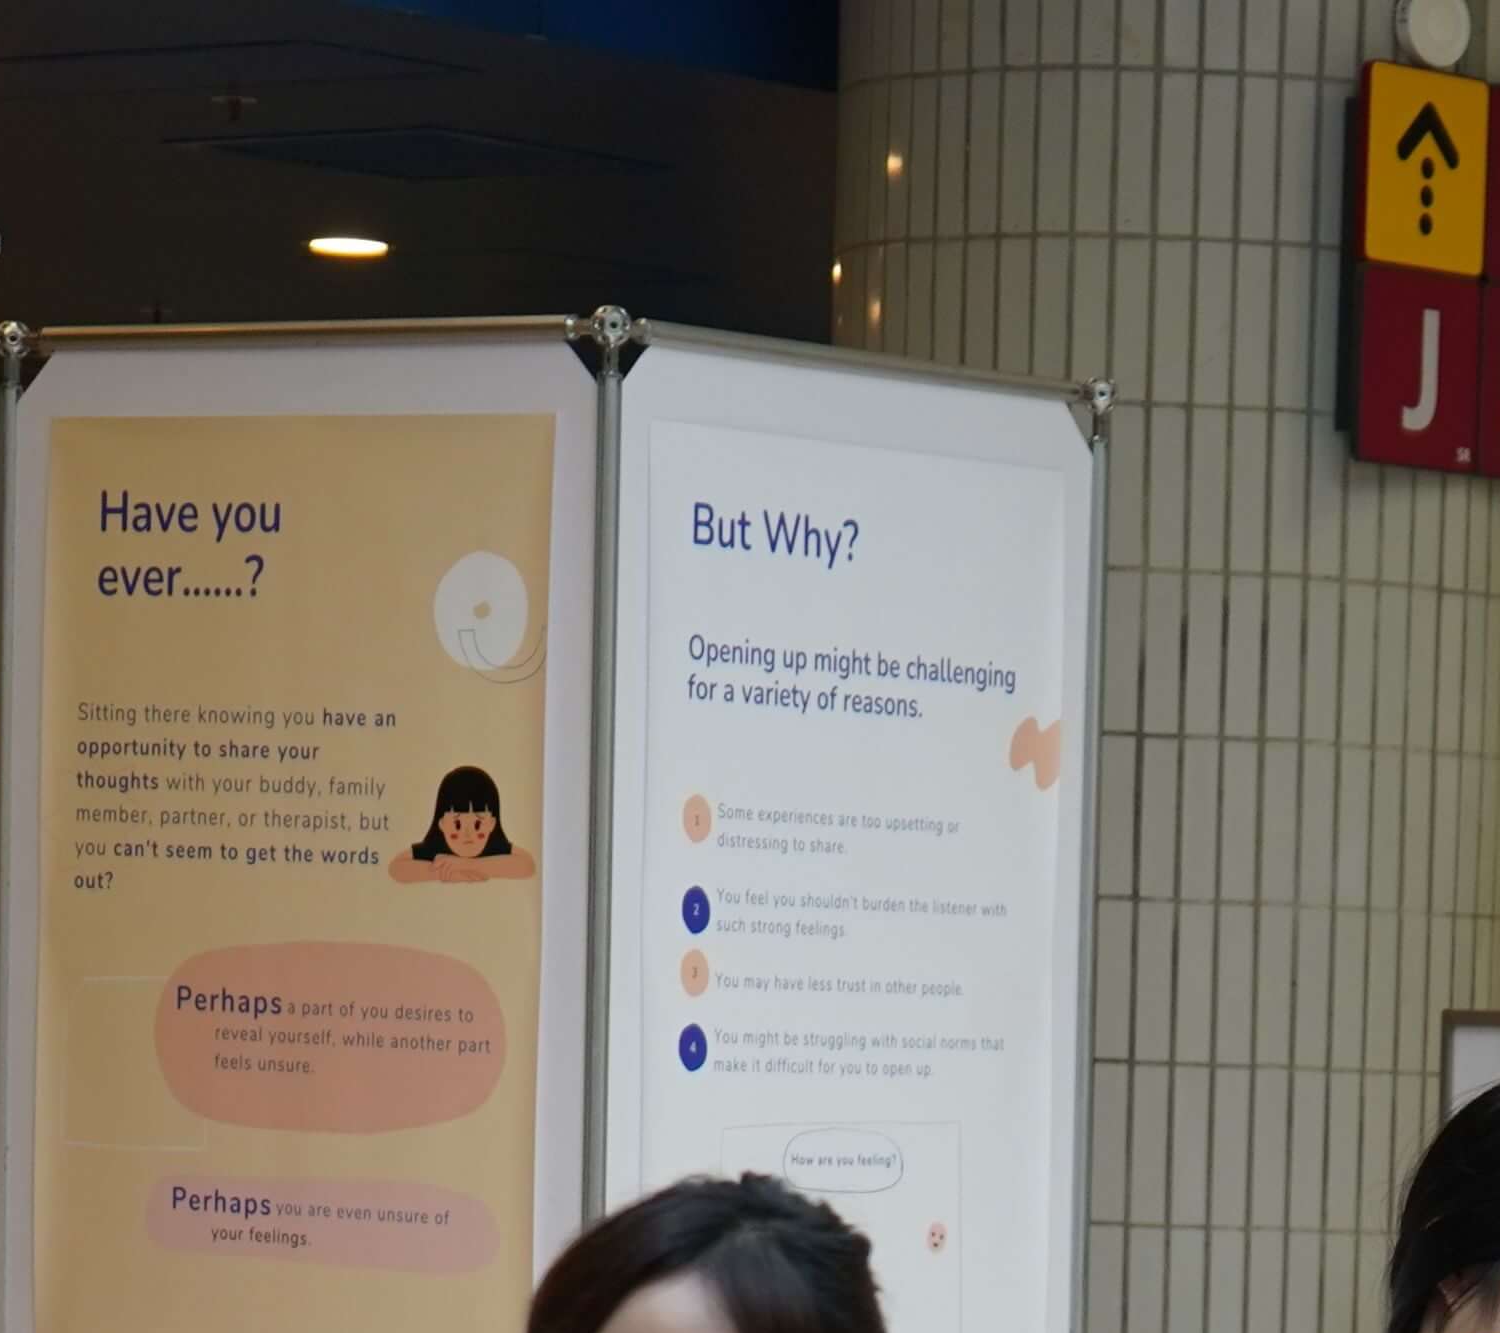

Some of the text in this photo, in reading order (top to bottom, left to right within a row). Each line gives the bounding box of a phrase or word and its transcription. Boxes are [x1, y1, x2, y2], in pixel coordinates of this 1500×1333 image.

[1401, 308, 1441, 432] J
[101, 490, 280, 542] Have you
[693, 502, 858, 569] But Why?
[689, 634, 1015, 694] Opening up might be challenging
[78, 702, 396, 729] Sitting there knowing you have an
[688, 673, 922, 718] for a variety of reasons.
[791, 1154, 896, 1168] How are you feeling?
